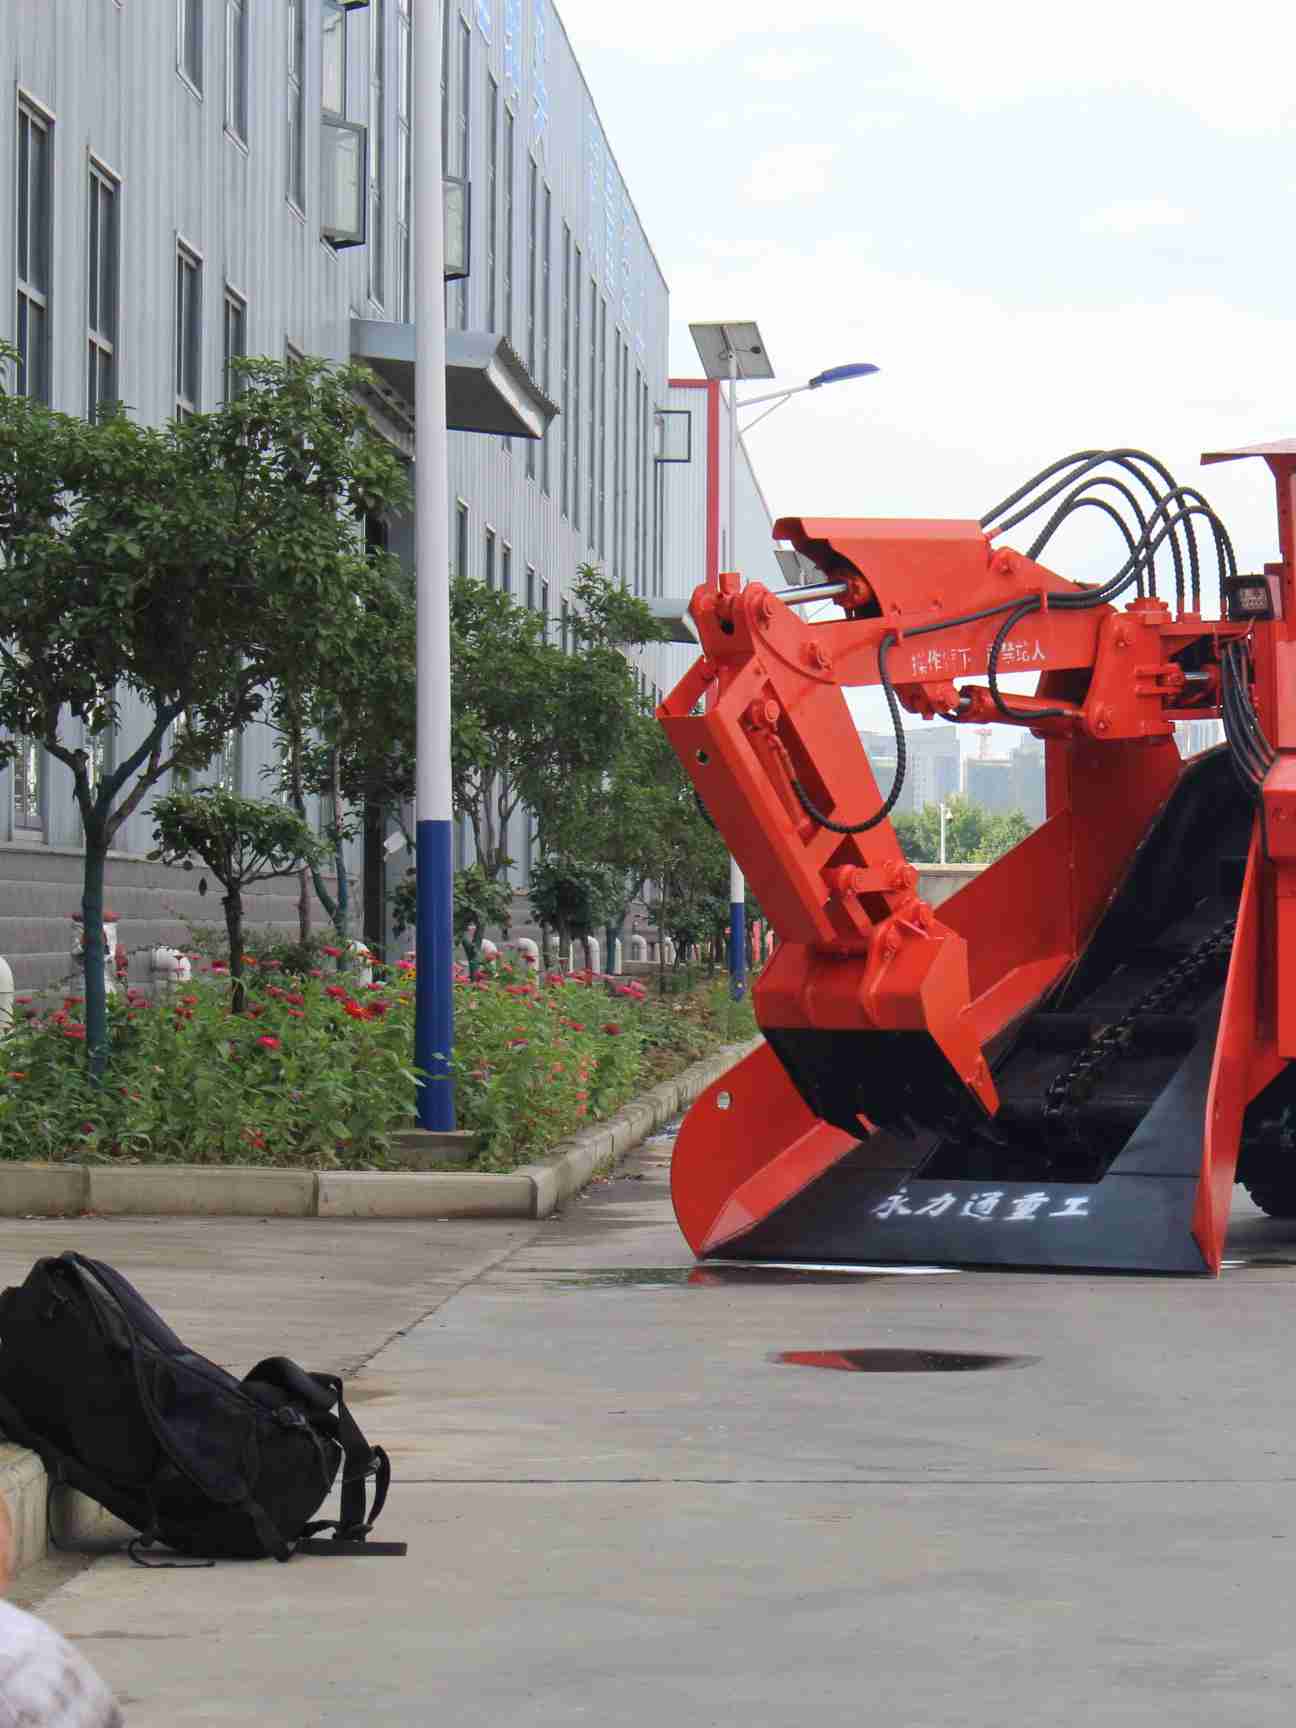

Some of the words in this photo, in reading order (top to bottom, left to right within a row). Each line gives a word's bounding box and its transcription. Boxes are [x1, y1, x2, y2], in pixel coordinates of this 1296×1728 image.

[871, 1186, 1090, 1221] 永力通重工
